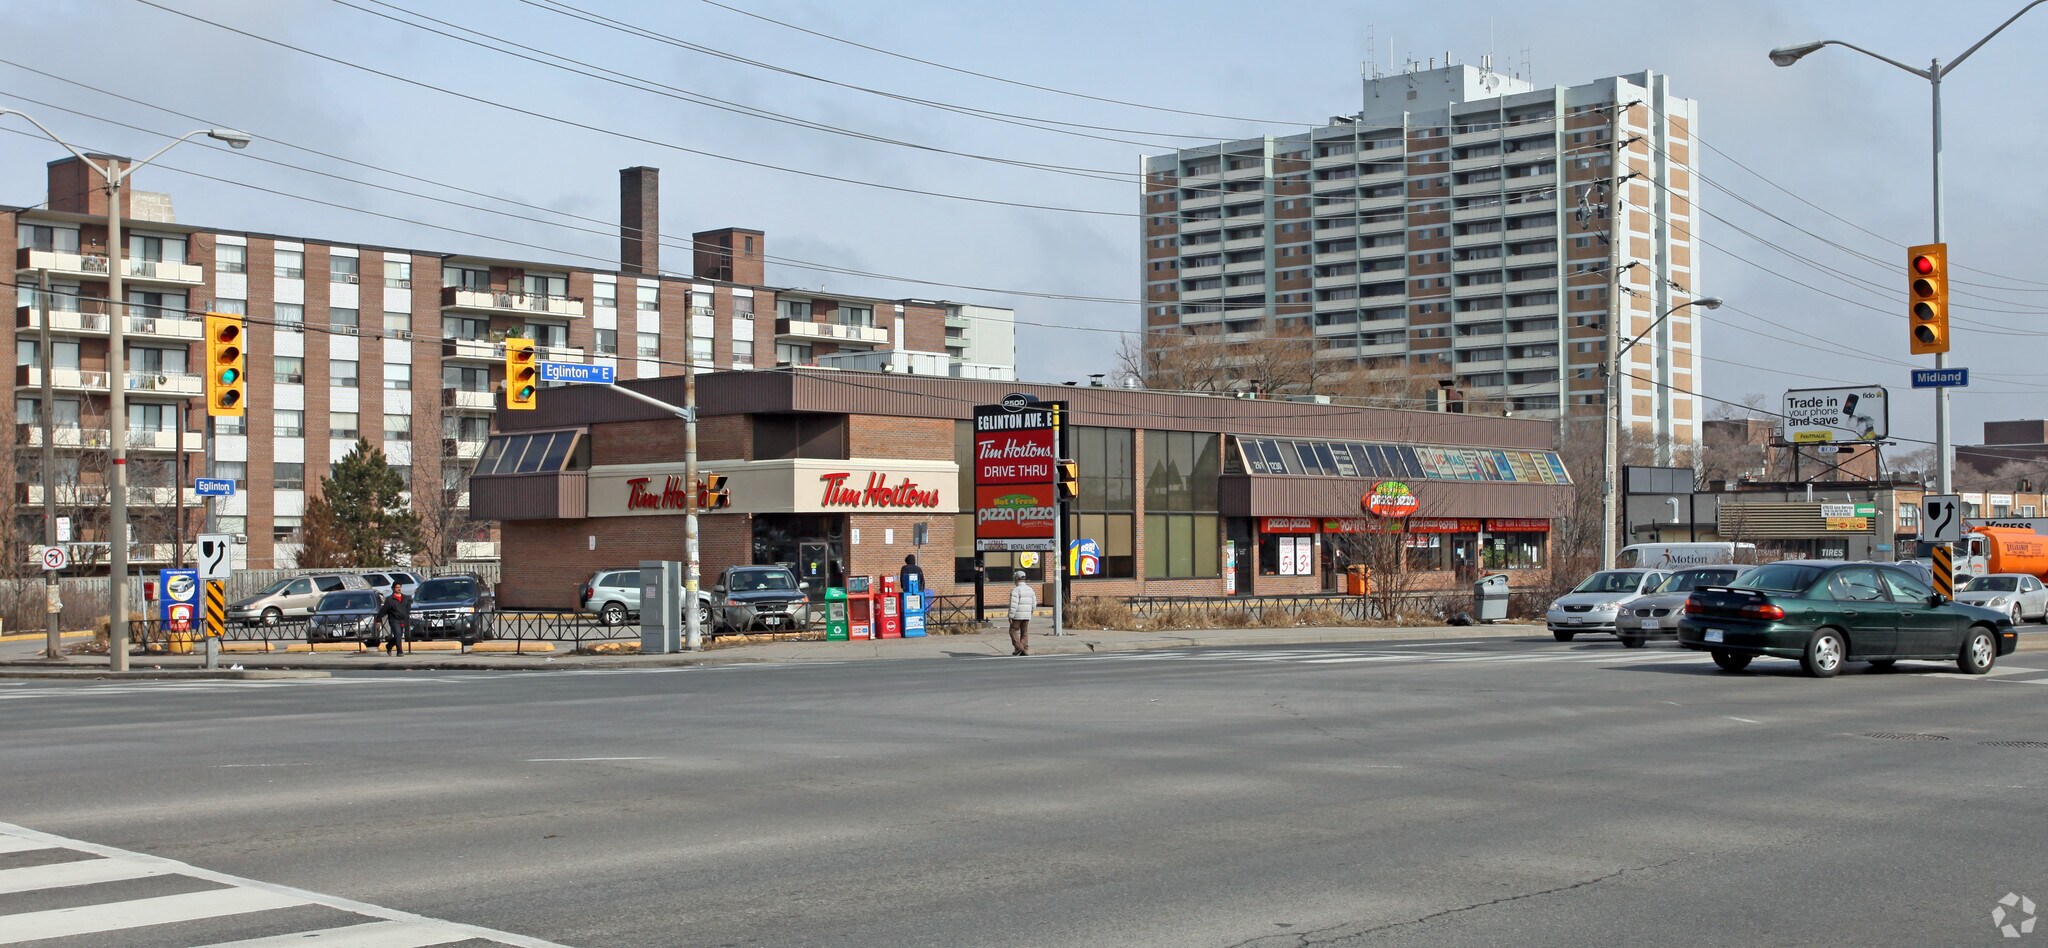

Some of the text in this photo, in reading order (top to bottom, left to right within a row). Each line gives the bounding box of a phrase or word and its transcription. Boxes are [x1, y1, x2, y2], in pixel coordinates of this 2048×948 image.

[546, 364, 589, 380] Eglinton
[602, 367, 610, 380] E
[1917, 372, 1962, 383] Midland
[1787, 396, 1838, 409] Trade in
[1788, 407, 1839, 418] your phone
[978, 412, 1053, 430] EGLINTON AVE. E
[1788, 416, 1839, 427] and save
[979, 440, 1003, 460] Tim
[984, 465, 1048, 478] DRIVE THRU
[199, 481, 230, 492] Eglinton
[820, 471, 939, 507] Tim Hortons
[627, 477, 661, 510] Tim
[978, 506, 1055, 526] pizza pizza
[1267, 519, 1311, 531] pizza pizza
